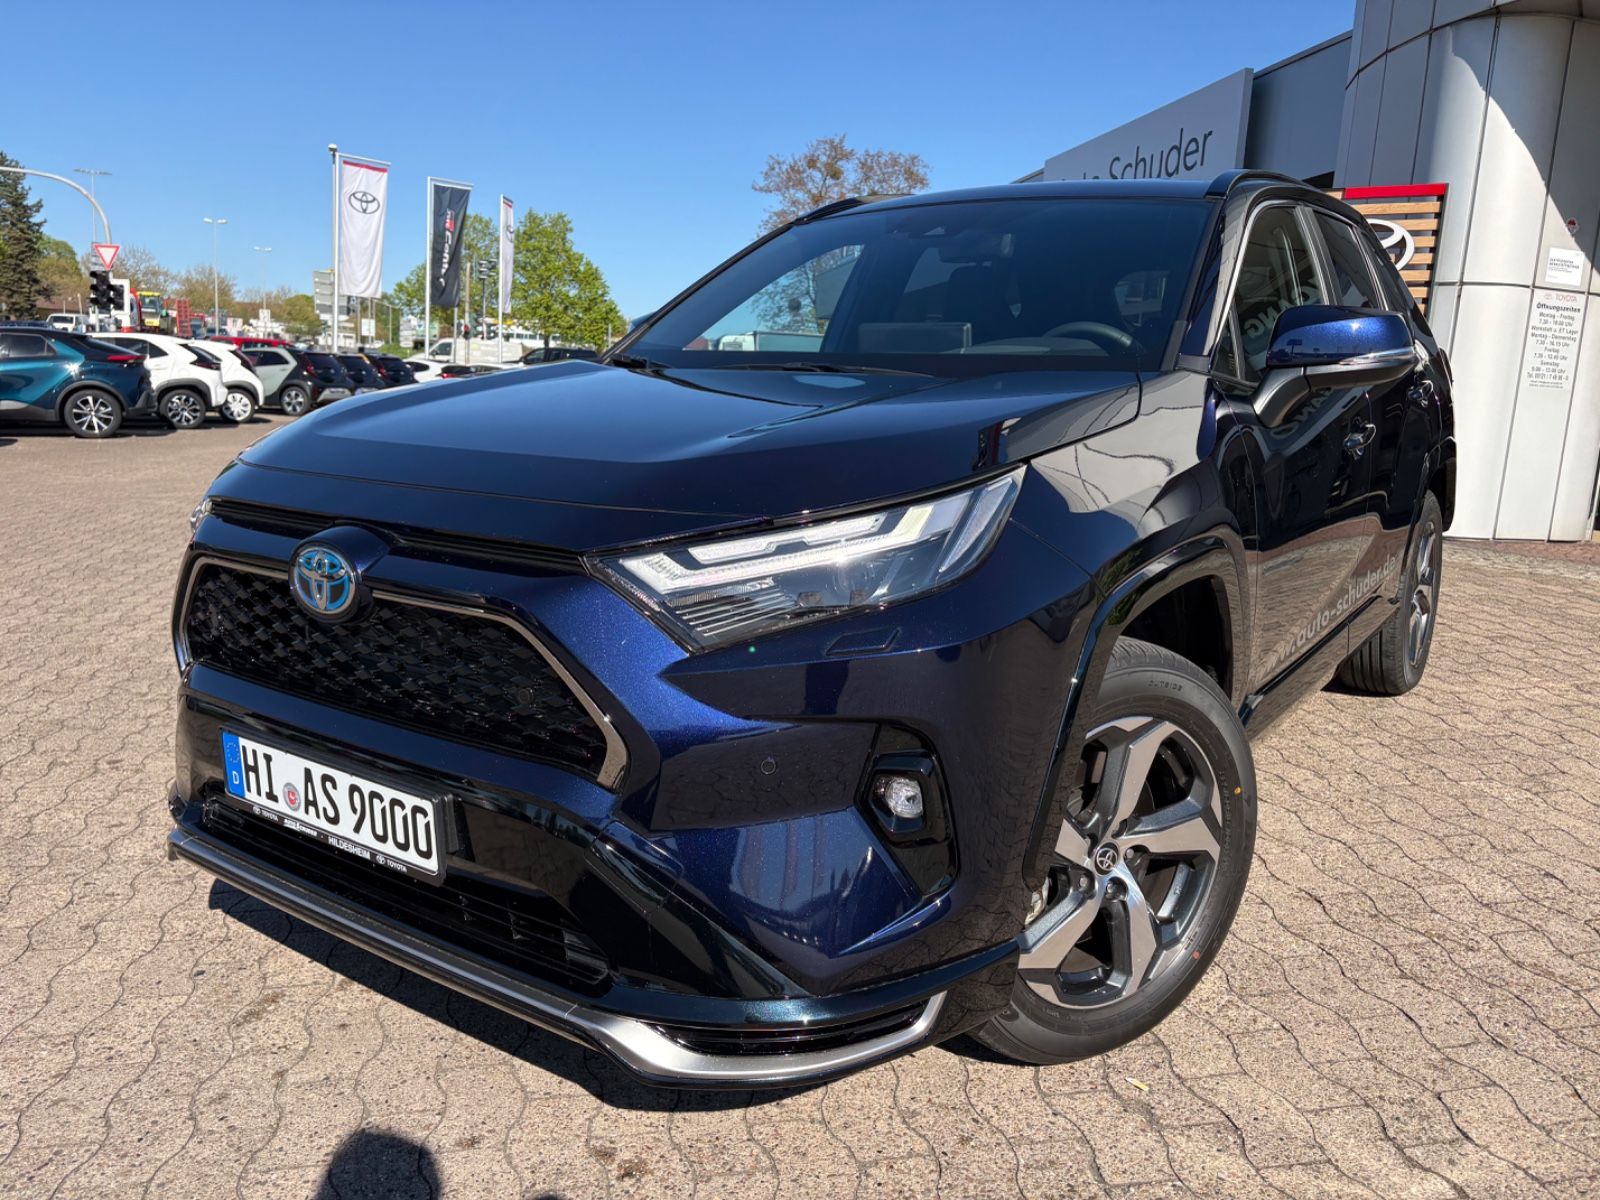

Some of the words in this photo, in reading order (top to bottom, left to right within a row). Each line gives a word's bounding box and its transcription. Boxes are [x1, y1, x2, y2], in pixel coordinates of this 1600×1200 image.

[1109, 127, 1213, 179] Schuder
[1536, 302, 1581, 313] Öffnungszeiten
[232, 770, 240, 785] D
[241, 745, 279, 804] HI
[304, 767, 341, 827] AS
[348, 783, 433, 861] 9000
[328, 835, 371, 860] HILDESHEIM
[387, 859, 408, 873] TOYOTA
